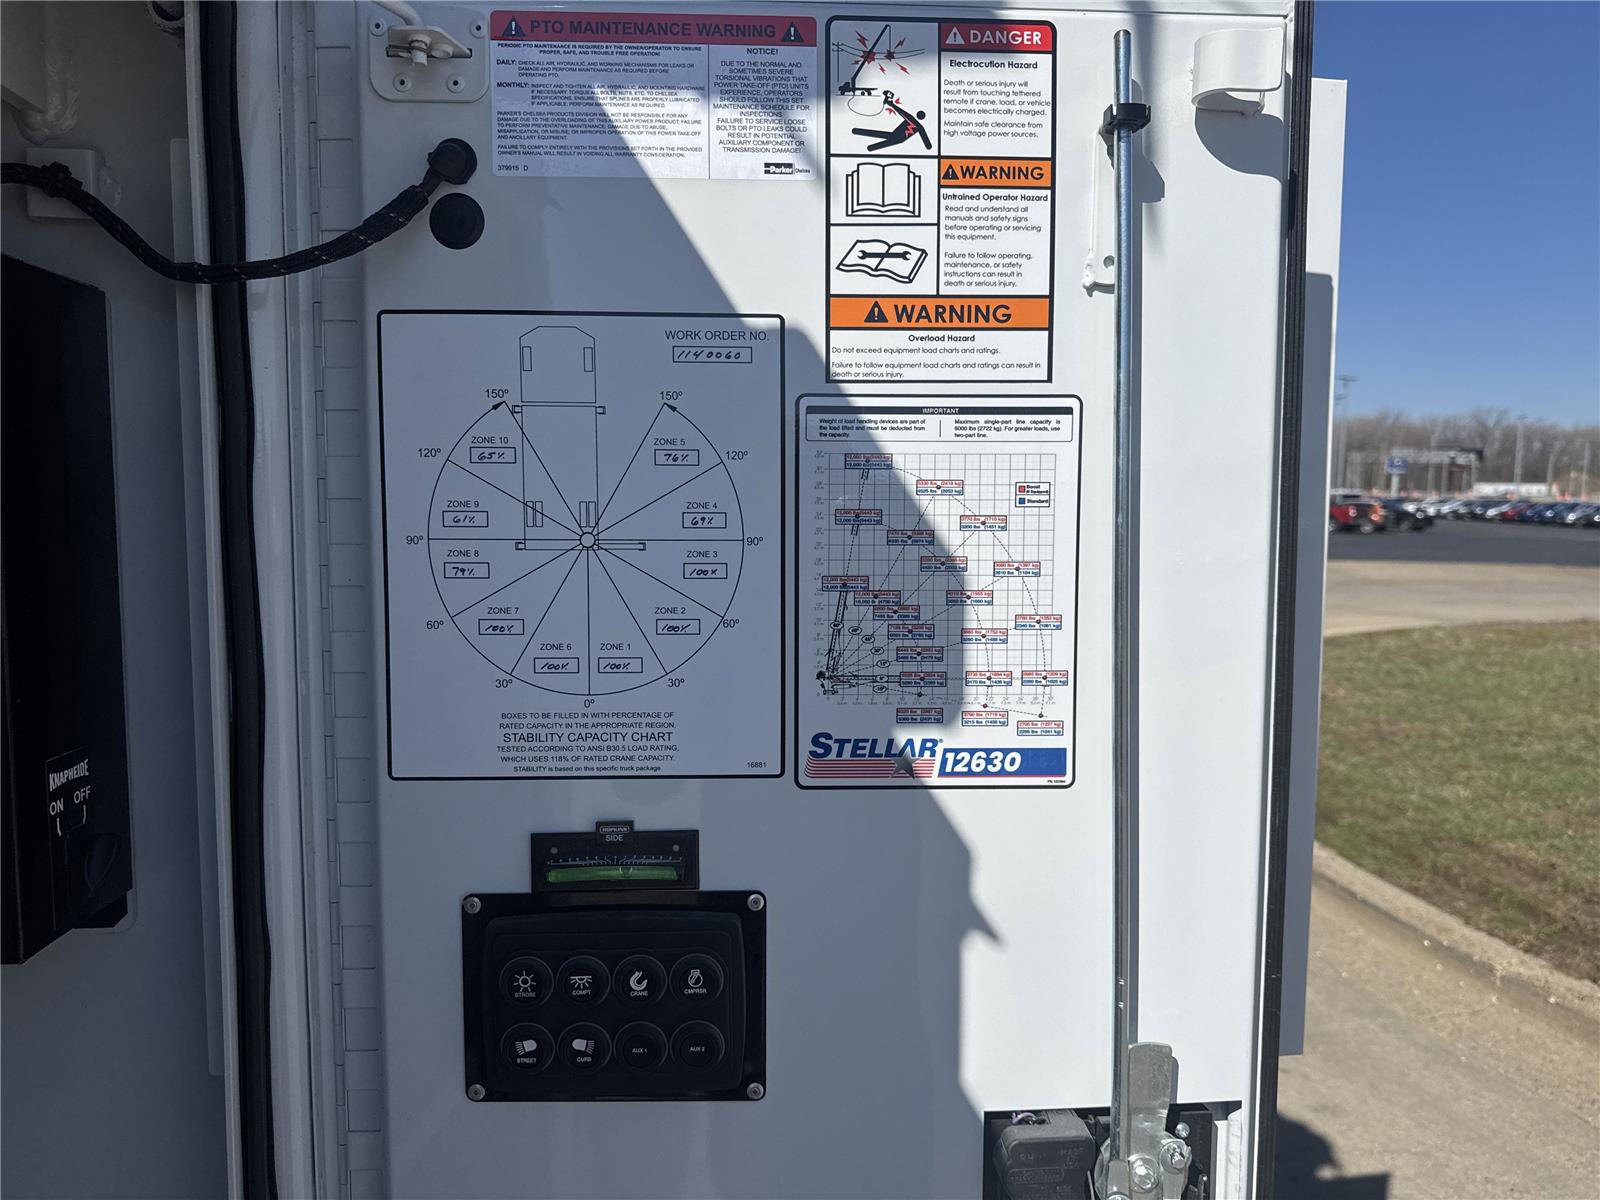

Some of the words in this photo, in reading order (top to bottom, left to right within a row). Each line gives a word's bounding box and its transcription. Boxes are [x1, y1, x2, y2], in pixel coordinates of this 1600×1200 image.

[530, 20, 563, 34] PTO
[569, 20, 691, 36] MAINTENANCE
[696, 22, 776, 37] WARNING
[970, 30, 1041, 44] DANGER
[949, 59, 1005, 68] Electrocution
[1008, 60, 1037, 68] Hazard
[999, 79, 1016, 88] injury
[980, 88, 1010, 98] touching
[770, 166, 793, 174] Parker
[960, 165, 1044, 180] WARNING
[942, 192, 980, 200] Untrained
[982, 192, 1018, 203] Operator
[990, 214, 1010, 223] safety
[1012, 214, 1028, 224] signs
[893, 304, 1011, 323] WARNING
[664, 329, 701, 340] WORK
[704, 330, 746, 340] ORDER
[750, 330, 769, 340] NO.
[883, 346, 920, 355] equipment
[976, 346, 1000, 356] ratings.
[653, 437, 677, 446] ZONE
[446, 499, 471, 507] ZONE
[686, 501, 709, 509] ZONE
[686, 550, 710, 558] ZONE
[487, 606, 511, 614] ZONE
[654, 606, 678, 614] ZONE
[502, 732, 564, 742] STABILITY
[567, 732, 627, 742] CAPACITY
[631, 731, 672, 741] CHART
[809, 732, 938, 758] STELLAR
[945, 751, 1021, 772] 12630
[49, 758, 89, 792] KNAPHEIDE
[74, 785, 91, 804] OFF
[50, 798, 64, 815] ON
